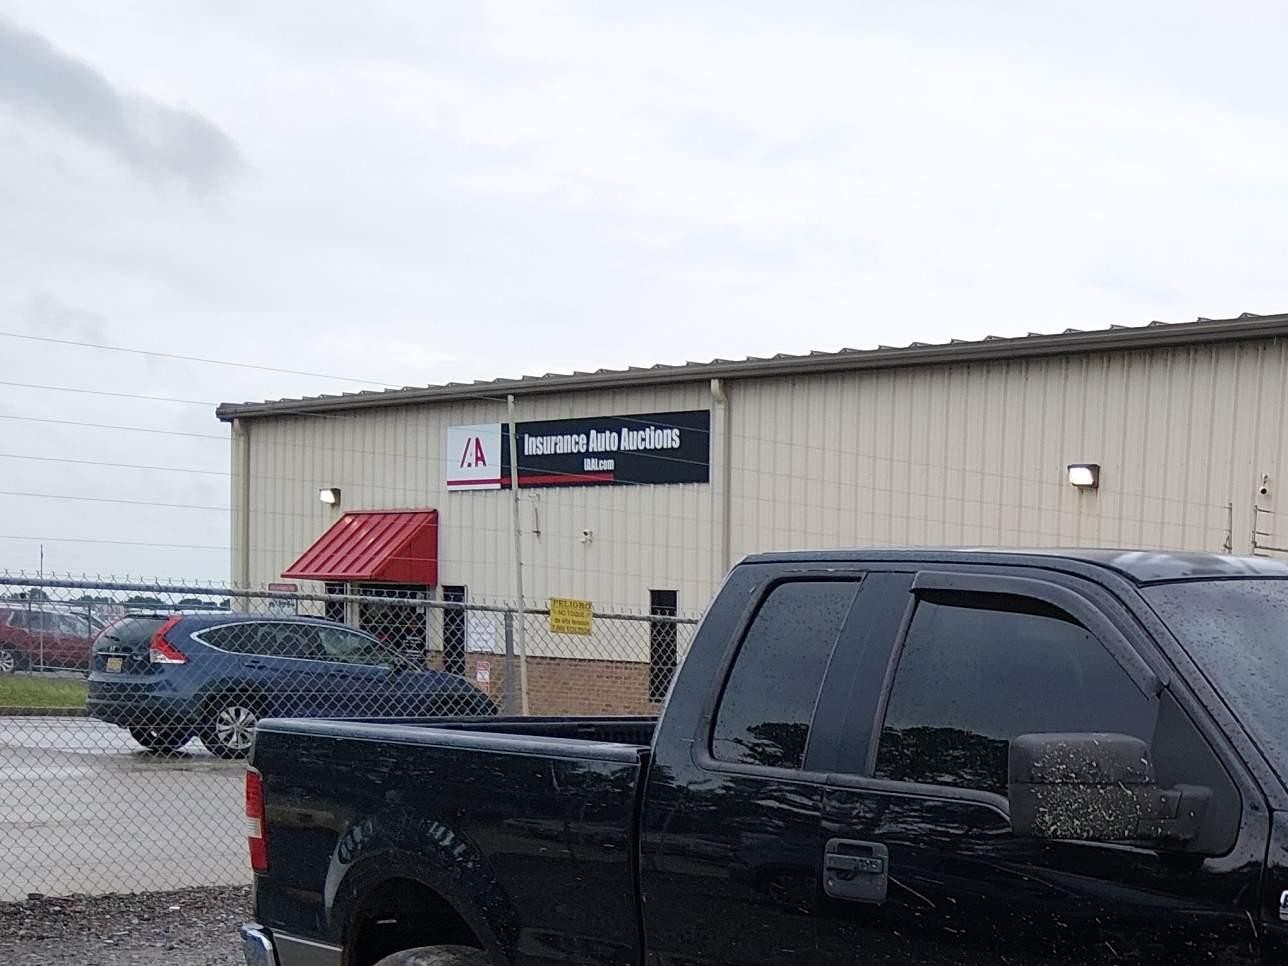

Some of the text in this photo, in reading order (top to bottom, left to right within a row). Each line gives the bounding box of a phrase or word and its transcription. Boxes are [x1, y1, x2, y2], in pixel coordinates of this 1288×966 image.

[524, 426, 681, 456] Insurance Auto Auctions
[552, 599, 592, 609] PELIGRO
